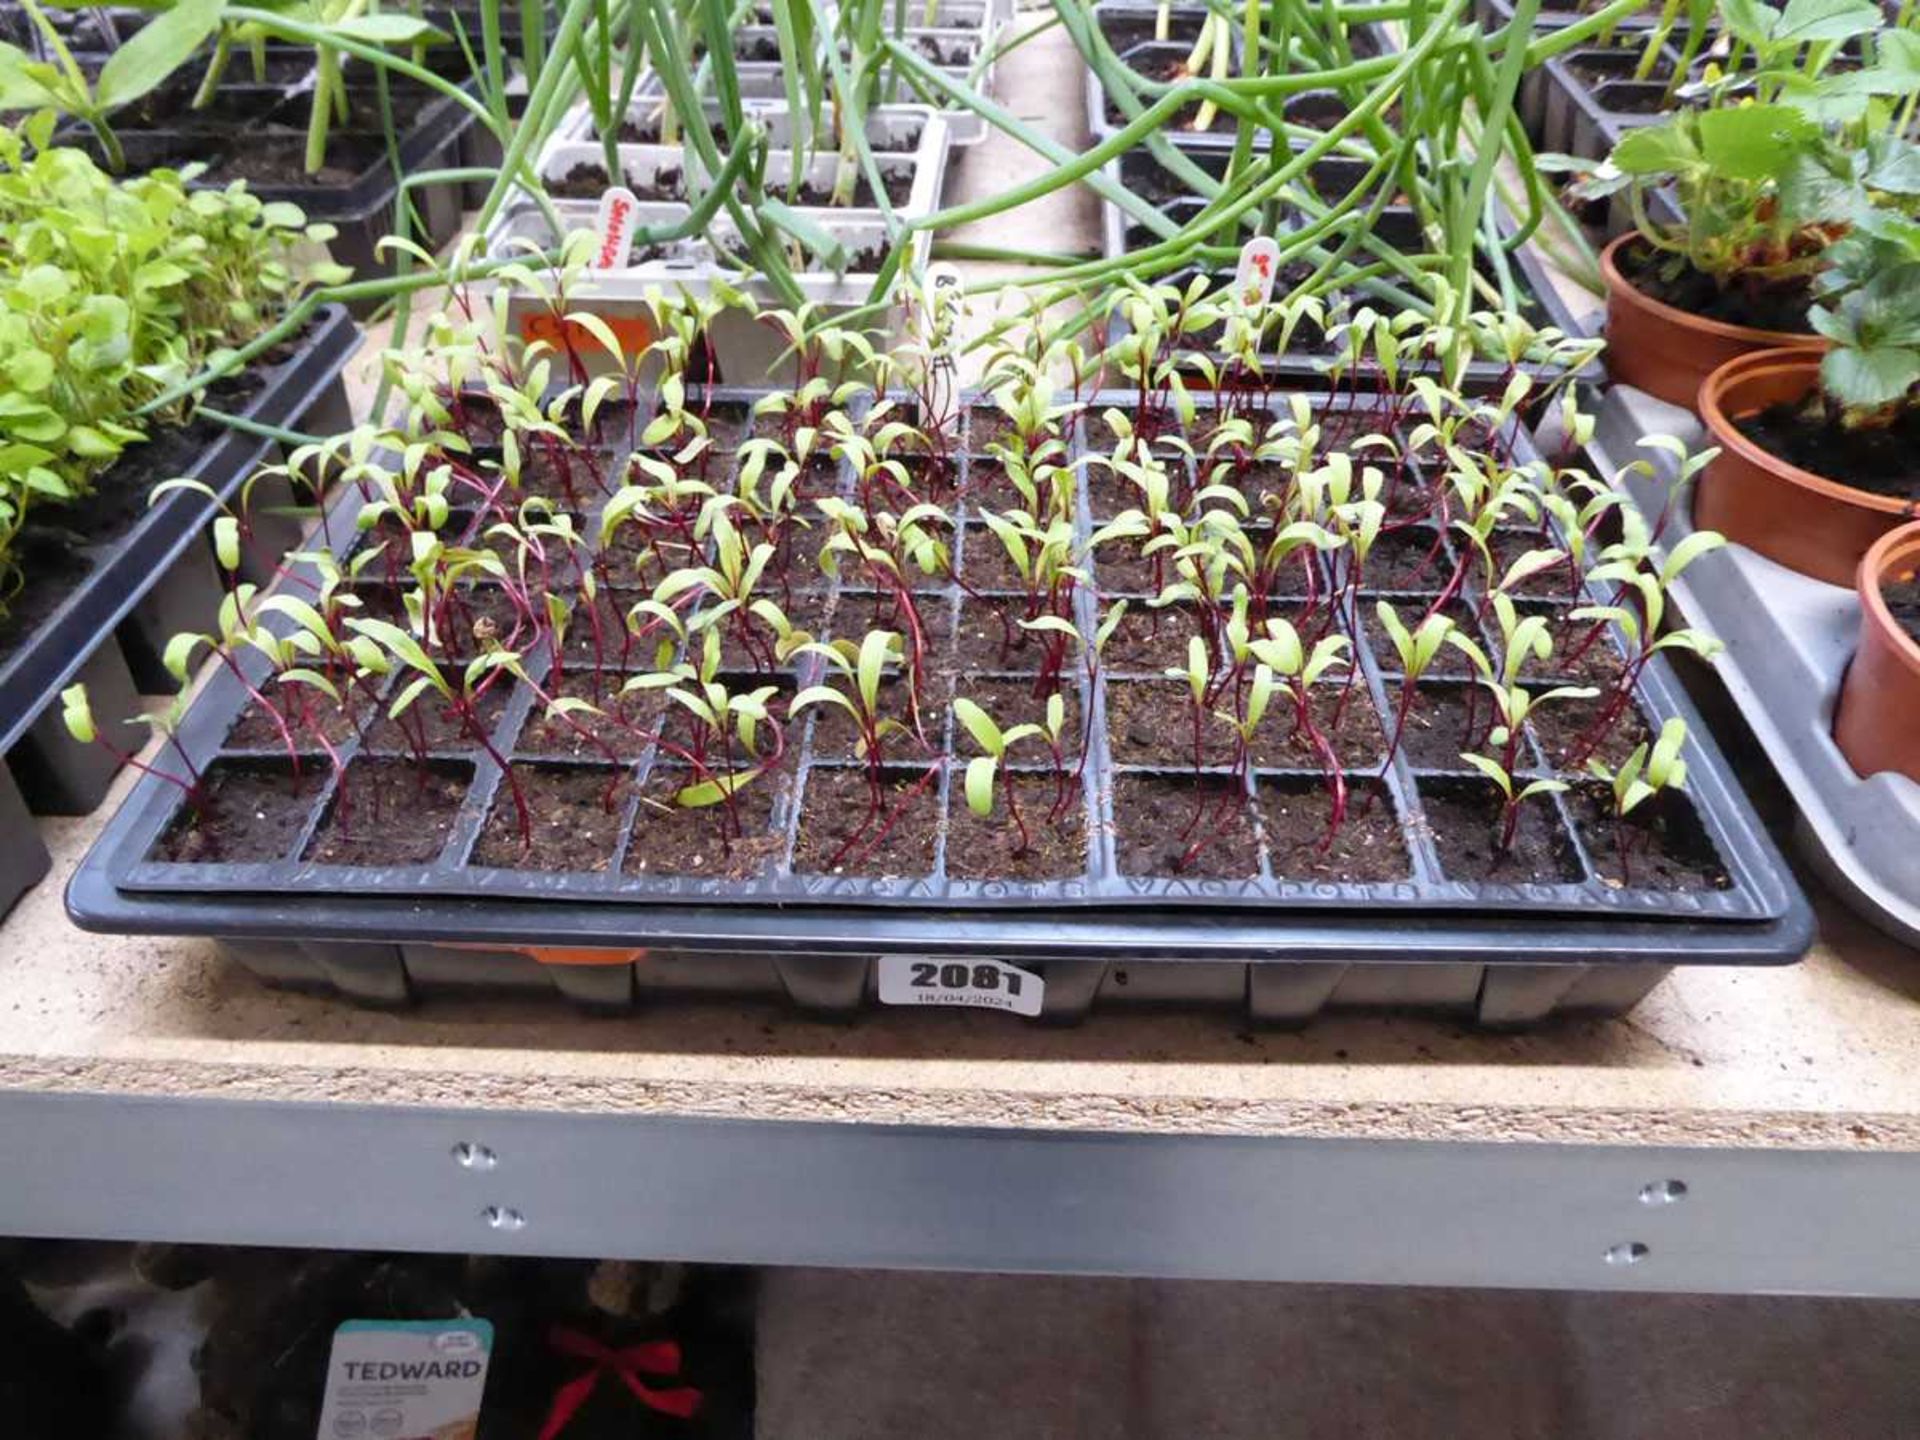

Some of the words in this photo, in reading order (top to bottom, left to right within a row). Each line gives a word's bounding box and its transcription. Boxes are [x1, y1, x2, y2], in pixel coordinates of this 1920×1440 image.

[910, 963, 1022, 996] 2081
[917, 992, 1013, 1008] 18/04/2024
[343, 1360, 482, 1381] TEDWARD
